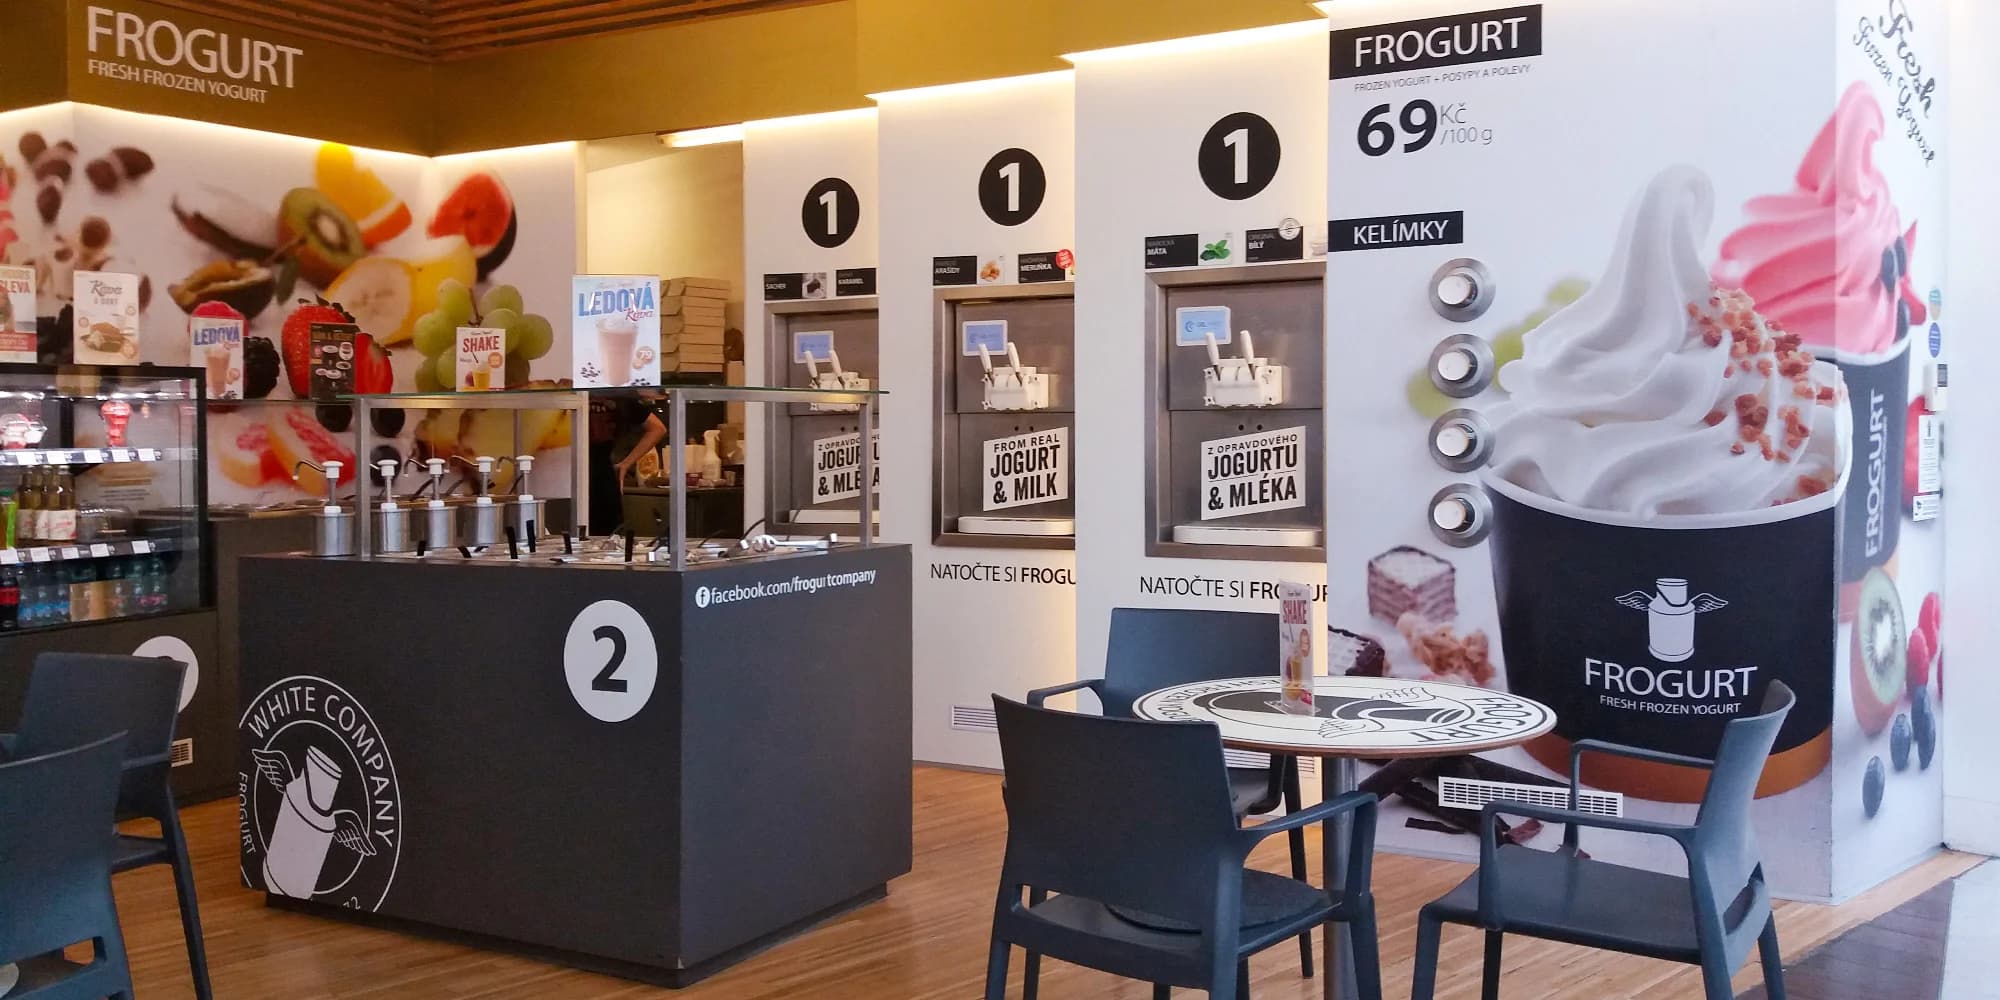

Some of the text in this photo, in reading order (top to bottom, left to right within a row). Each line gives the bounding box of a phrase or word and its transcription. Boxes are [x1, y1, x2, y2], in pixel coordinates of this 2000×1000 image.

[88, 6, 303, 88] FROGURT
[1355, 16, 1527, 68] FROGURT
[88, 59, 268, 104] FRESH FROZEN YOGURT
[1354, 79, 1391, 92] FROZEN
[1392, 75, 1431, 88] YOGURT
[1443, 69, 1480, 82] POSYPY
[1482, 67, 1490, 77] A
[1357, 99, 1468, 157] 69 Kč
[1482, 128, 1493, 145] g
[1224, 128, 1248, 184] 1
[999, 162, 1019, 212] 1
[819, 190, 837, 235] 1
[1353, 219, 1449, 245] KELÍMKY
[578, 282, 654, 316] LEDOVÁ
[463, 336, 500, 352] SHAKE
[993, 433, 1060, 452] FROM REAL
[1207, 434, 1298, 455] Z OPRAVDOVÉHO
[990, 444, 1060, 478] JOGURT
[1208, 444, 1298, 480] JOGURTU
[1865, 388, 1884, 558] FROGURT
[818, 477, 829, 496] &
[993, 472, 1057, 504] & MILK
[1207, 473, 1298, 511] & MLÉKA
[931, 561, 1000, 582] NATOČTE
[1004, 566, 1016, 583] SI
[1140, 575, 1224, 598] NATOČTE
[1229, 579, 1244, 598] SI
[592, 625, 627, 693] 2
[1585, 657, 1758, 699] FROGURT
[1408, 697, 1532, 743] FROGURT
[1600, 694, 1742, 715] FRESH FROZEN YOGURT
[248, 686, 395, 848] WHITE COMPANY
